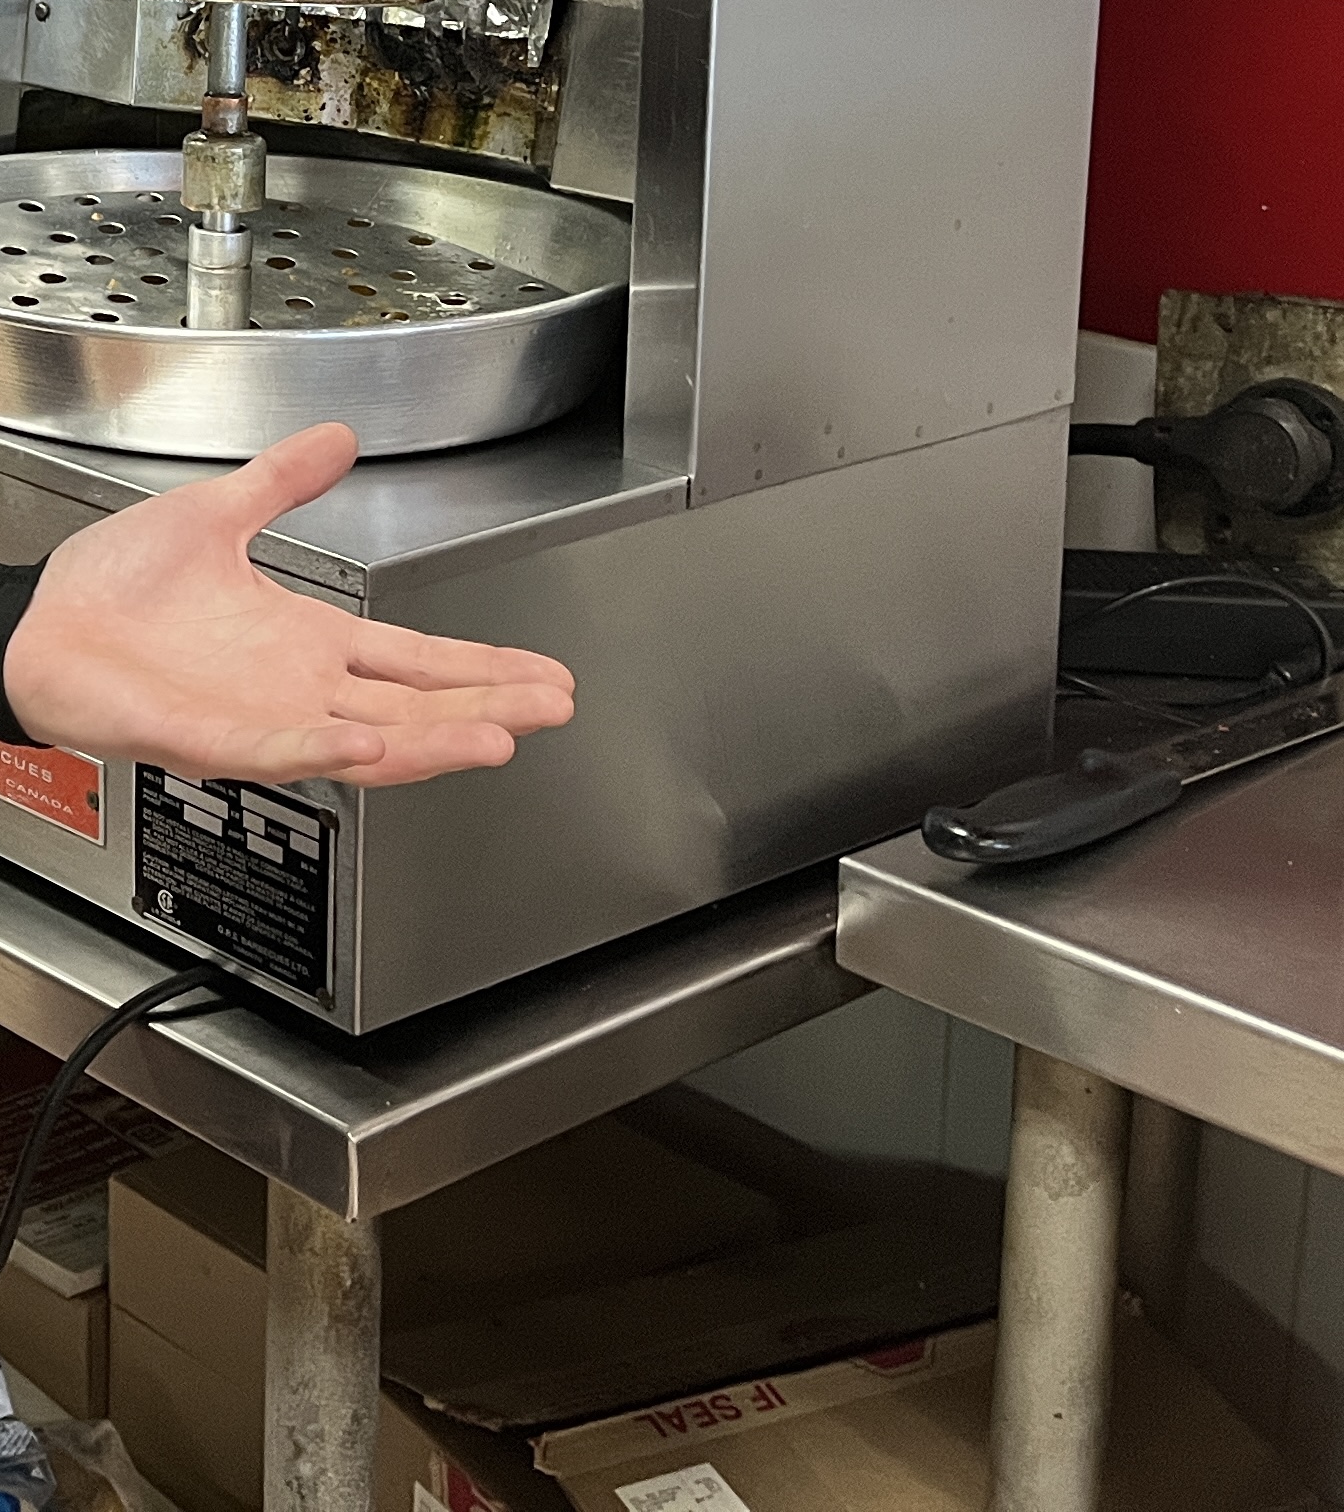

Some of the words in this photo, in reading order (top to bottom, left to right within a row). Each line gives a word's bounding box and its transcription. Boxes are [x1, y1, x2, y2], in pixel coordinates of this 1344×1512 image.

[5, 778, 74, 816] CANADA
[632, 1392, 743, 1439] SEAL
[750, 1380, 787, 1414] IF
